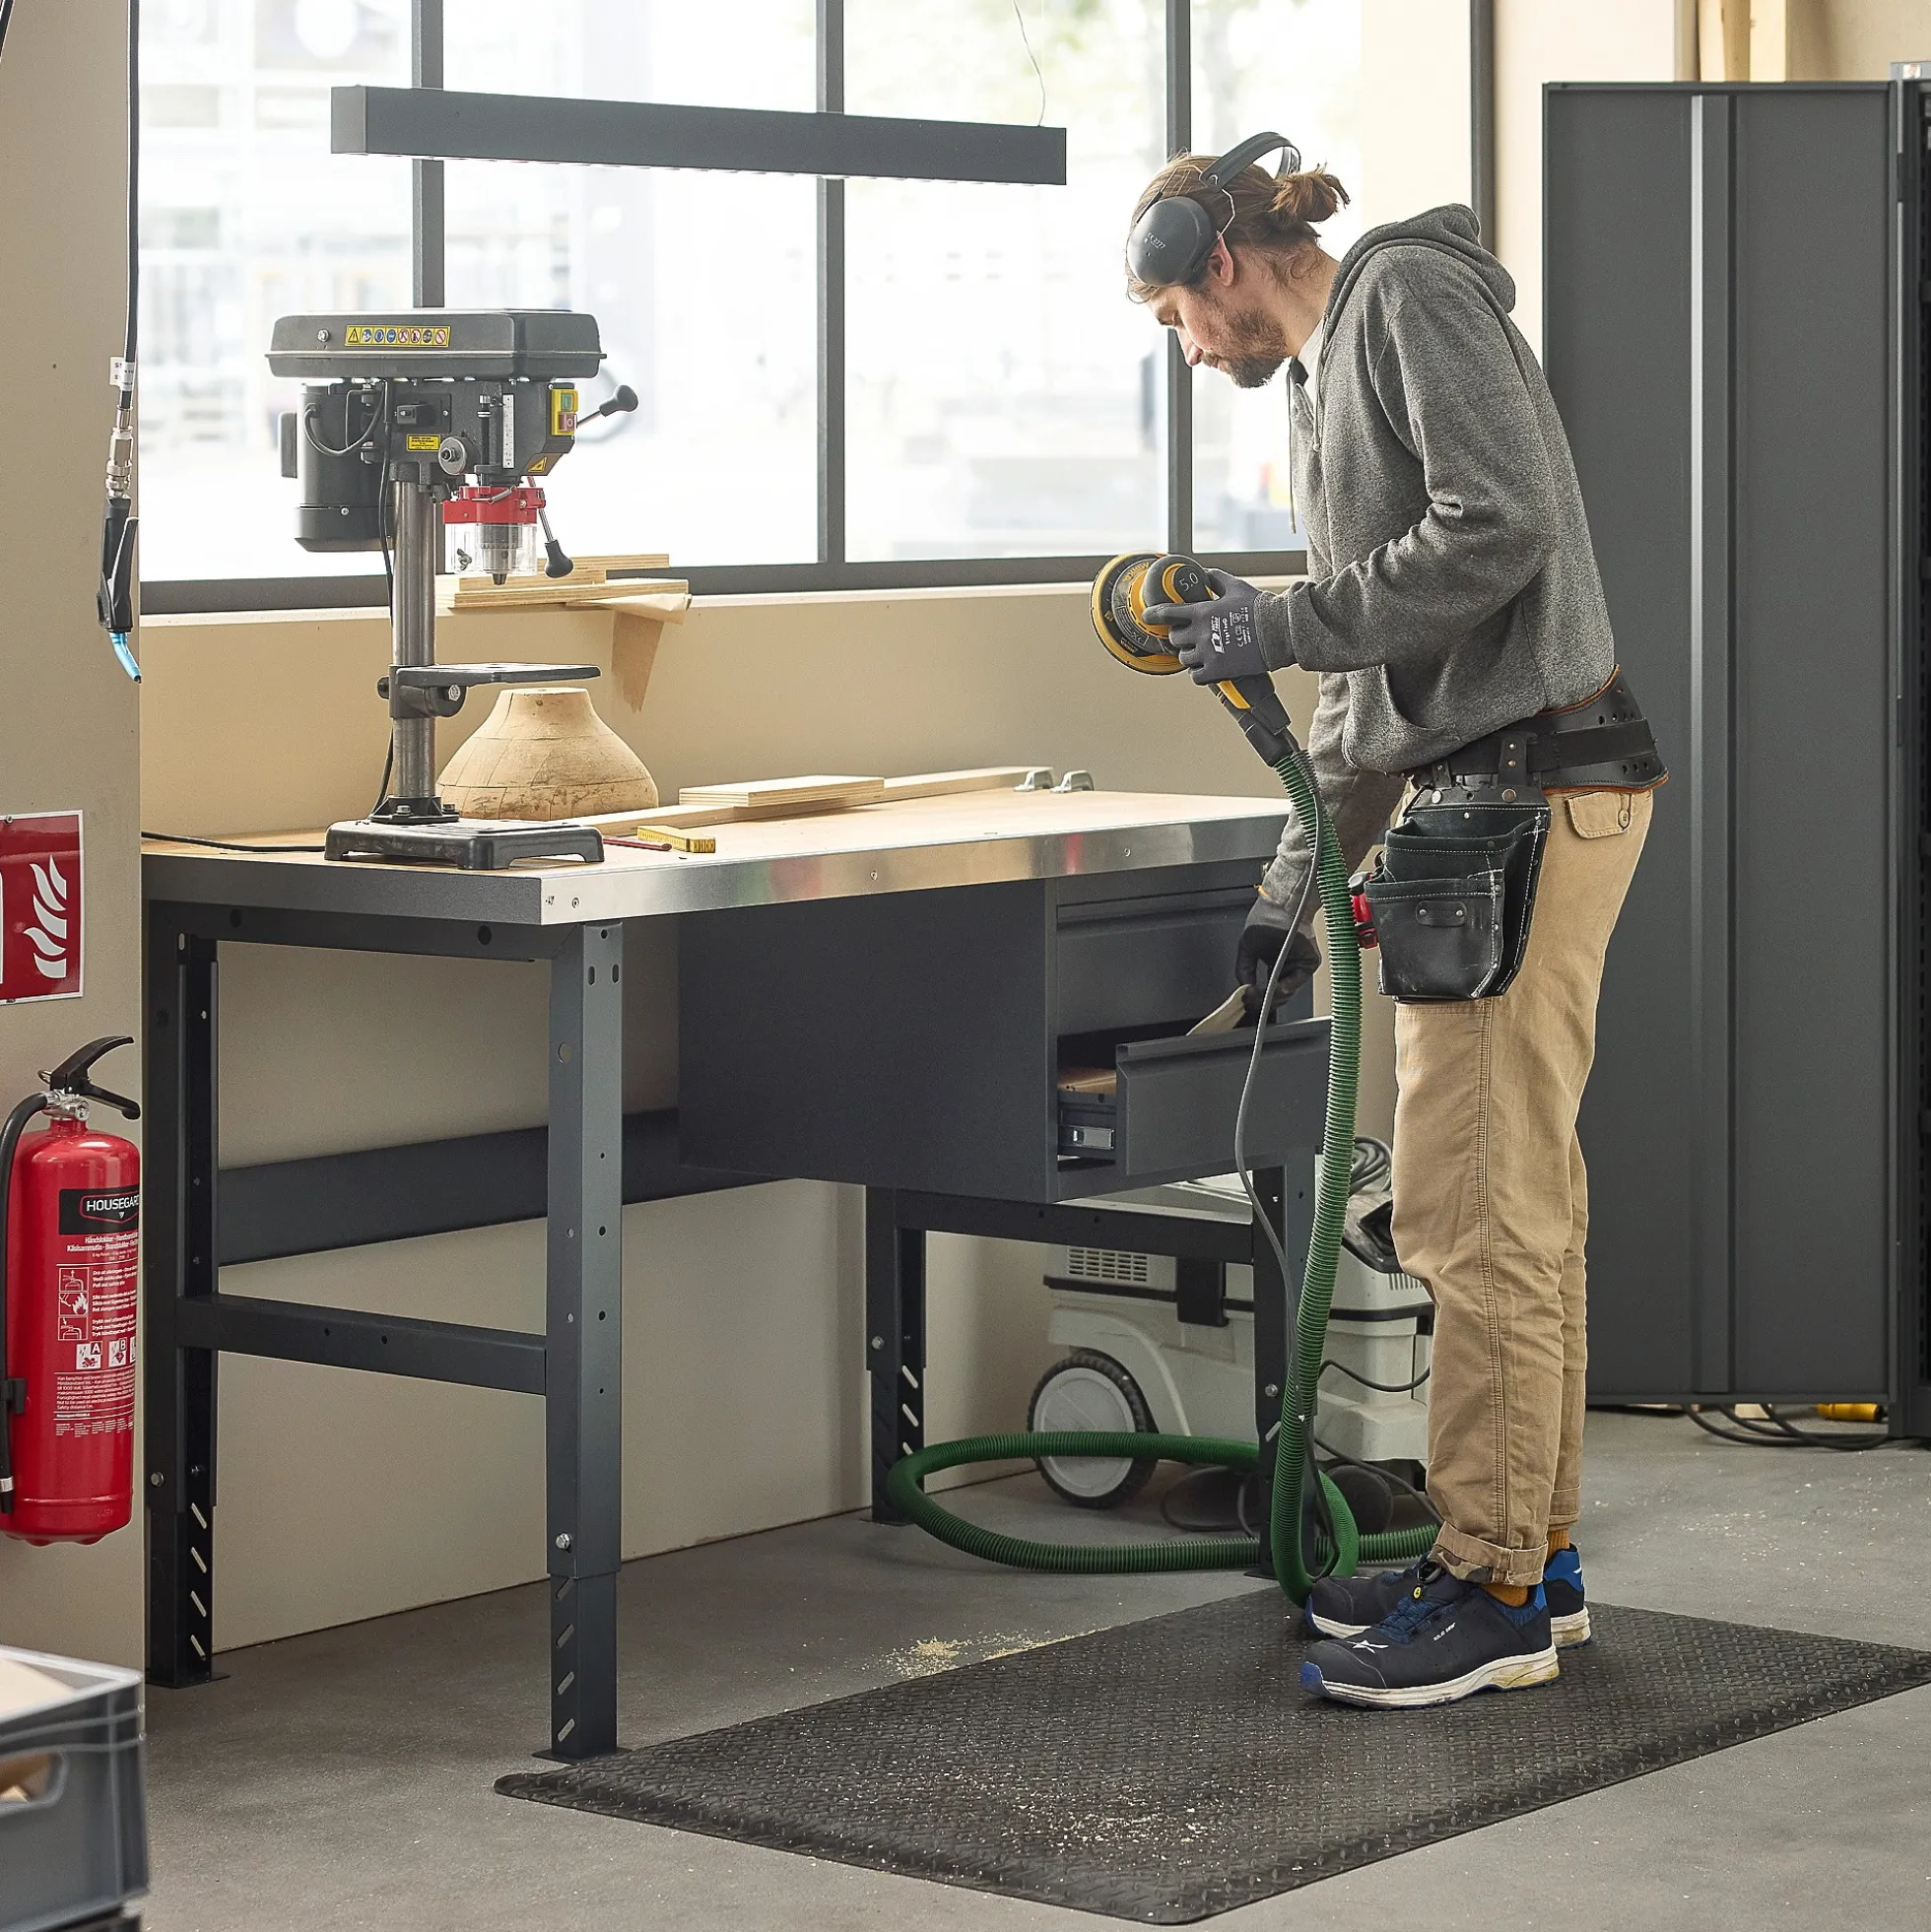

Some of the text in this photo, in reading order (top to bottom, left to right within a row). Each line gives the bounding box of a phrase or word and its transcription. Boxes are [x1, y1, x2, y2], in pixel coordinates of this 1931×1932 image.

[1179, 571, 1199, 593] 5.0
[92, 1343, 101, 1354] A
[119, 1340, 127, 1351] B
